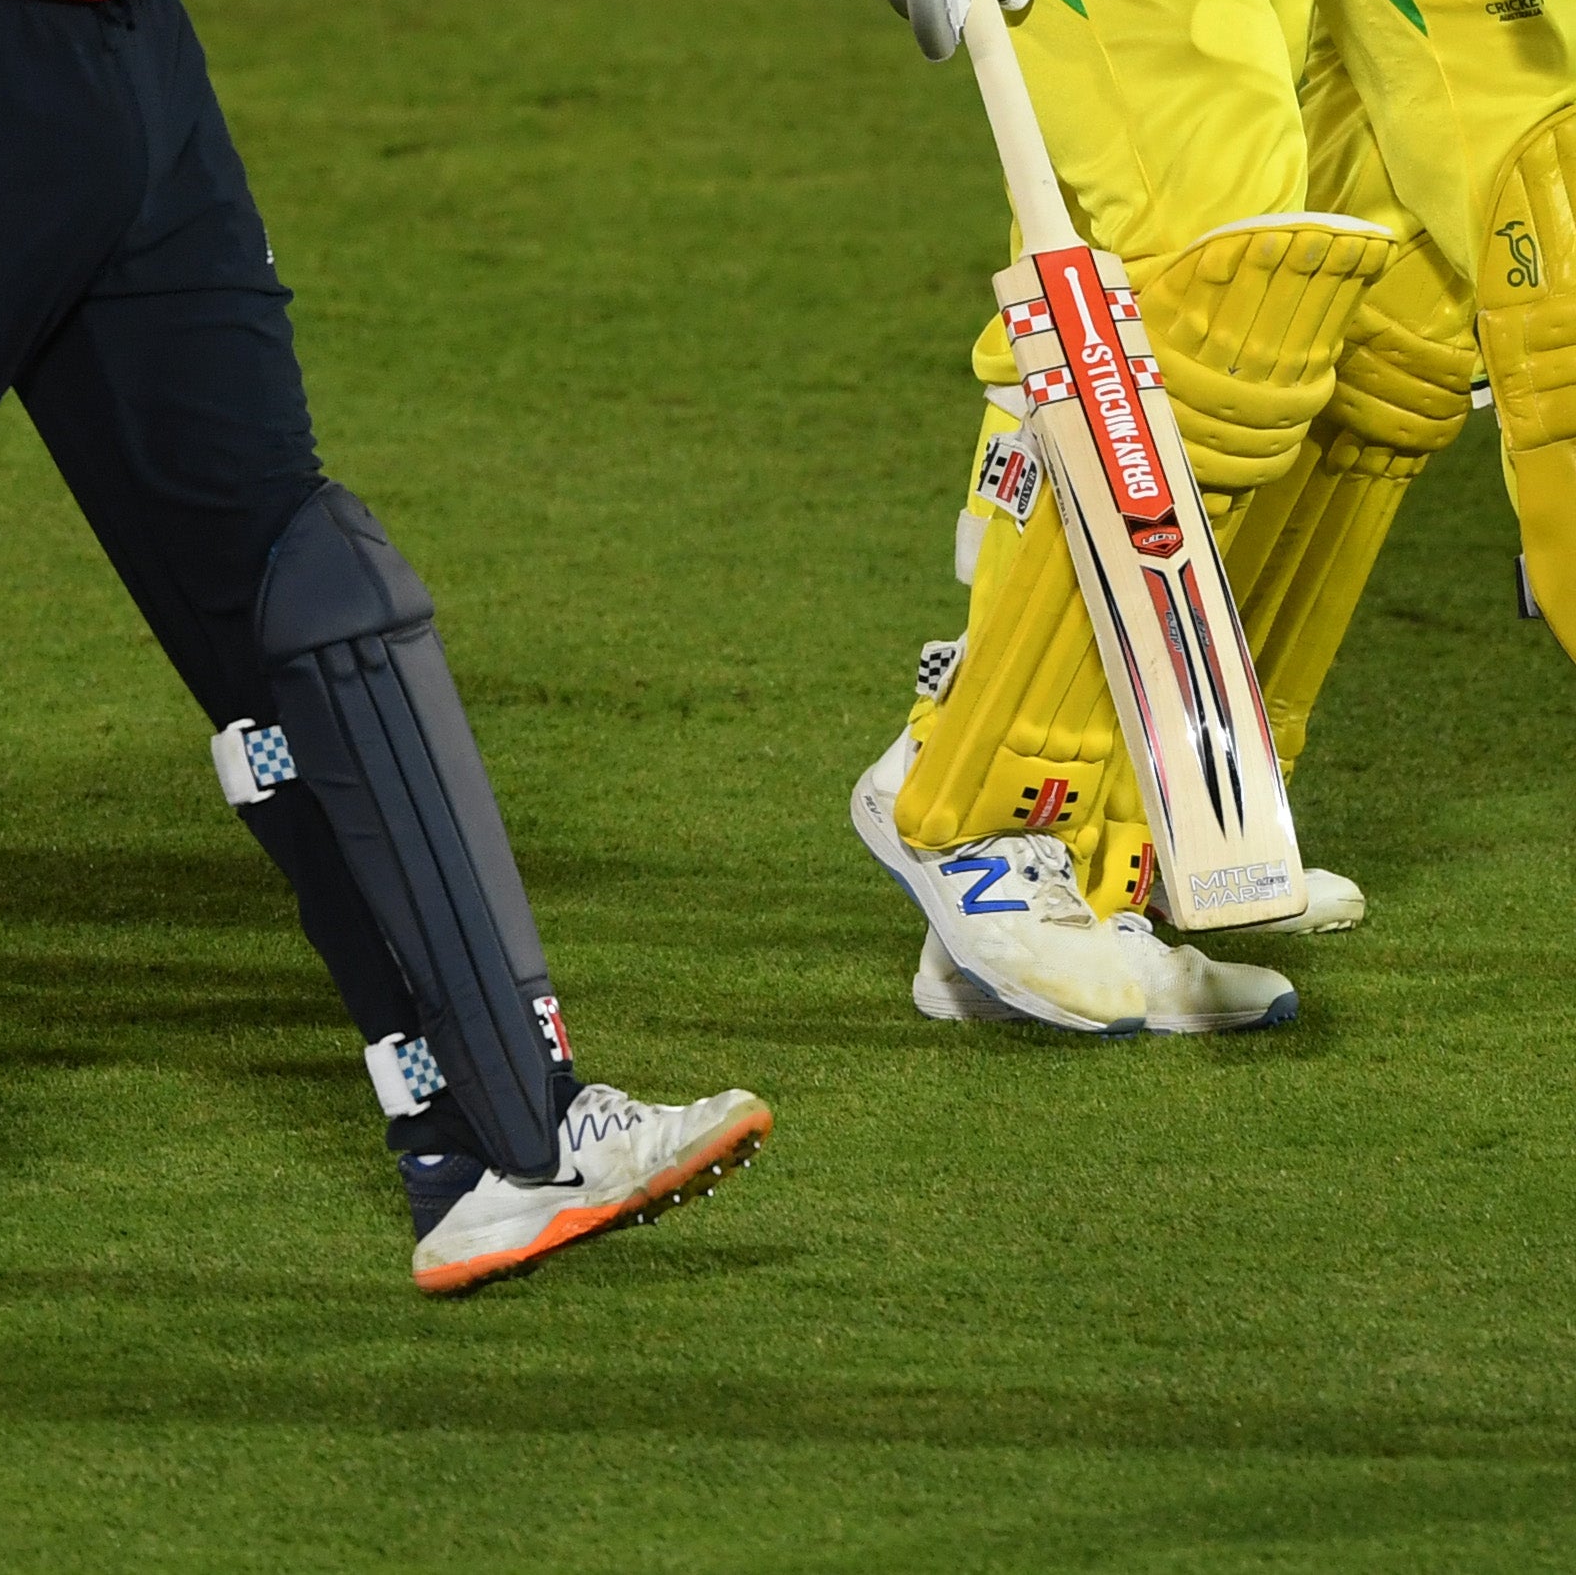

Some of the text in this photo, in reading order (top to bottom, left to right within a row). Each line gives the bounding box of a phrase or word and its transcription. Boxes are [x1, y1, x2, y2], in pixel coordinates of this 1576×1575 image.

[1081, 344, 1159, 500] GRAY-NICOLLS
[1019, 468, 1038, 512] SILVER
[1189, 859, 1288, 892] MITCH
[1193, 880, 1292, 911] MARSH
